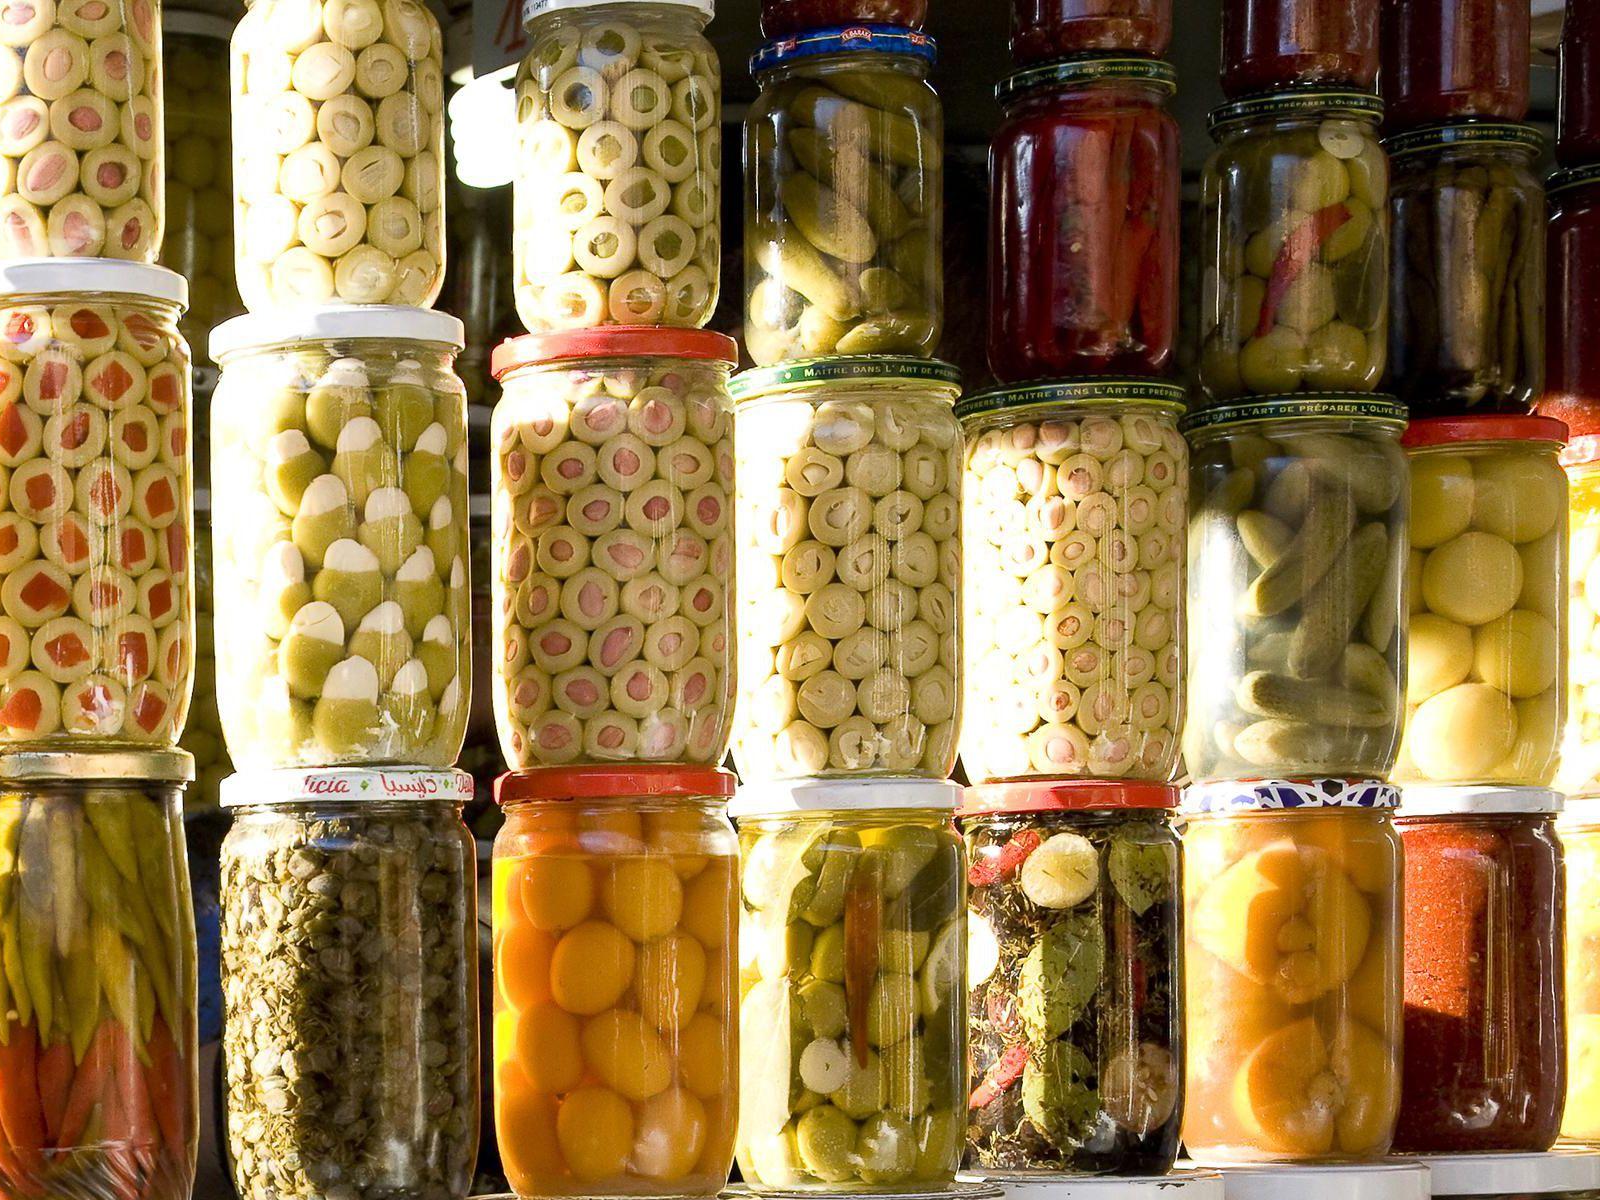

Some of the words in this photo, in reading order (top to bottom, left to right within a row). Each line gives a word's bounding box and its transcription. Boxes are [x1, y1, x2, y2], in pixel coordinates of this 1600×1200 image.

[852, 366, 881, 374] DANS
[1056, 387, 1089, 397] DANS
[1132, 387, 1146, 395] DE
[1279, 405, 1295, 414] DE
[1299, 402, 1358, 412] PRÉPARER
